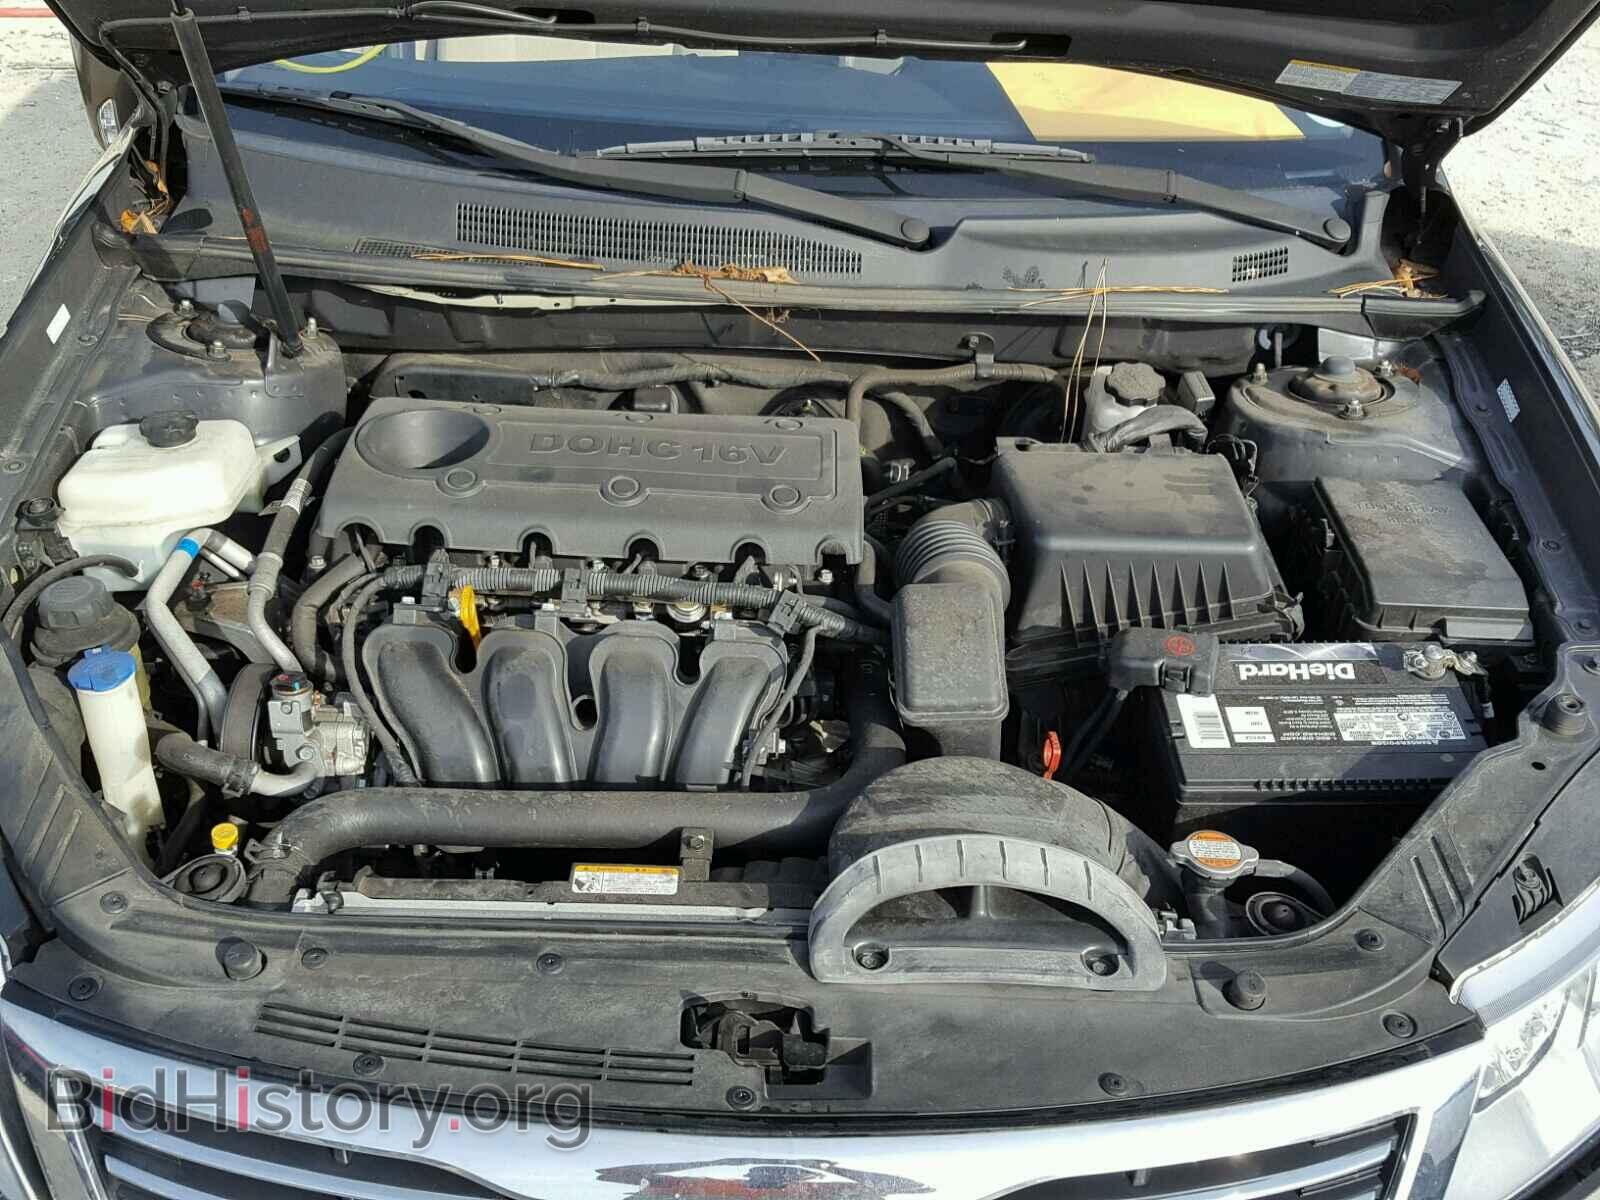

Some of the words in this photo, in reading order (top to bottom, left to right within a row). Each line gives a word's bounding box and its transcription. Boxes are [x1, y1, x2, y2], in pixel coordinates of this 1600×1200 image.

[529, 431, 682, 460] DOHC
[692, 443, 789, 466] 16V
[1239, 662, 1356, 681] DieHard
